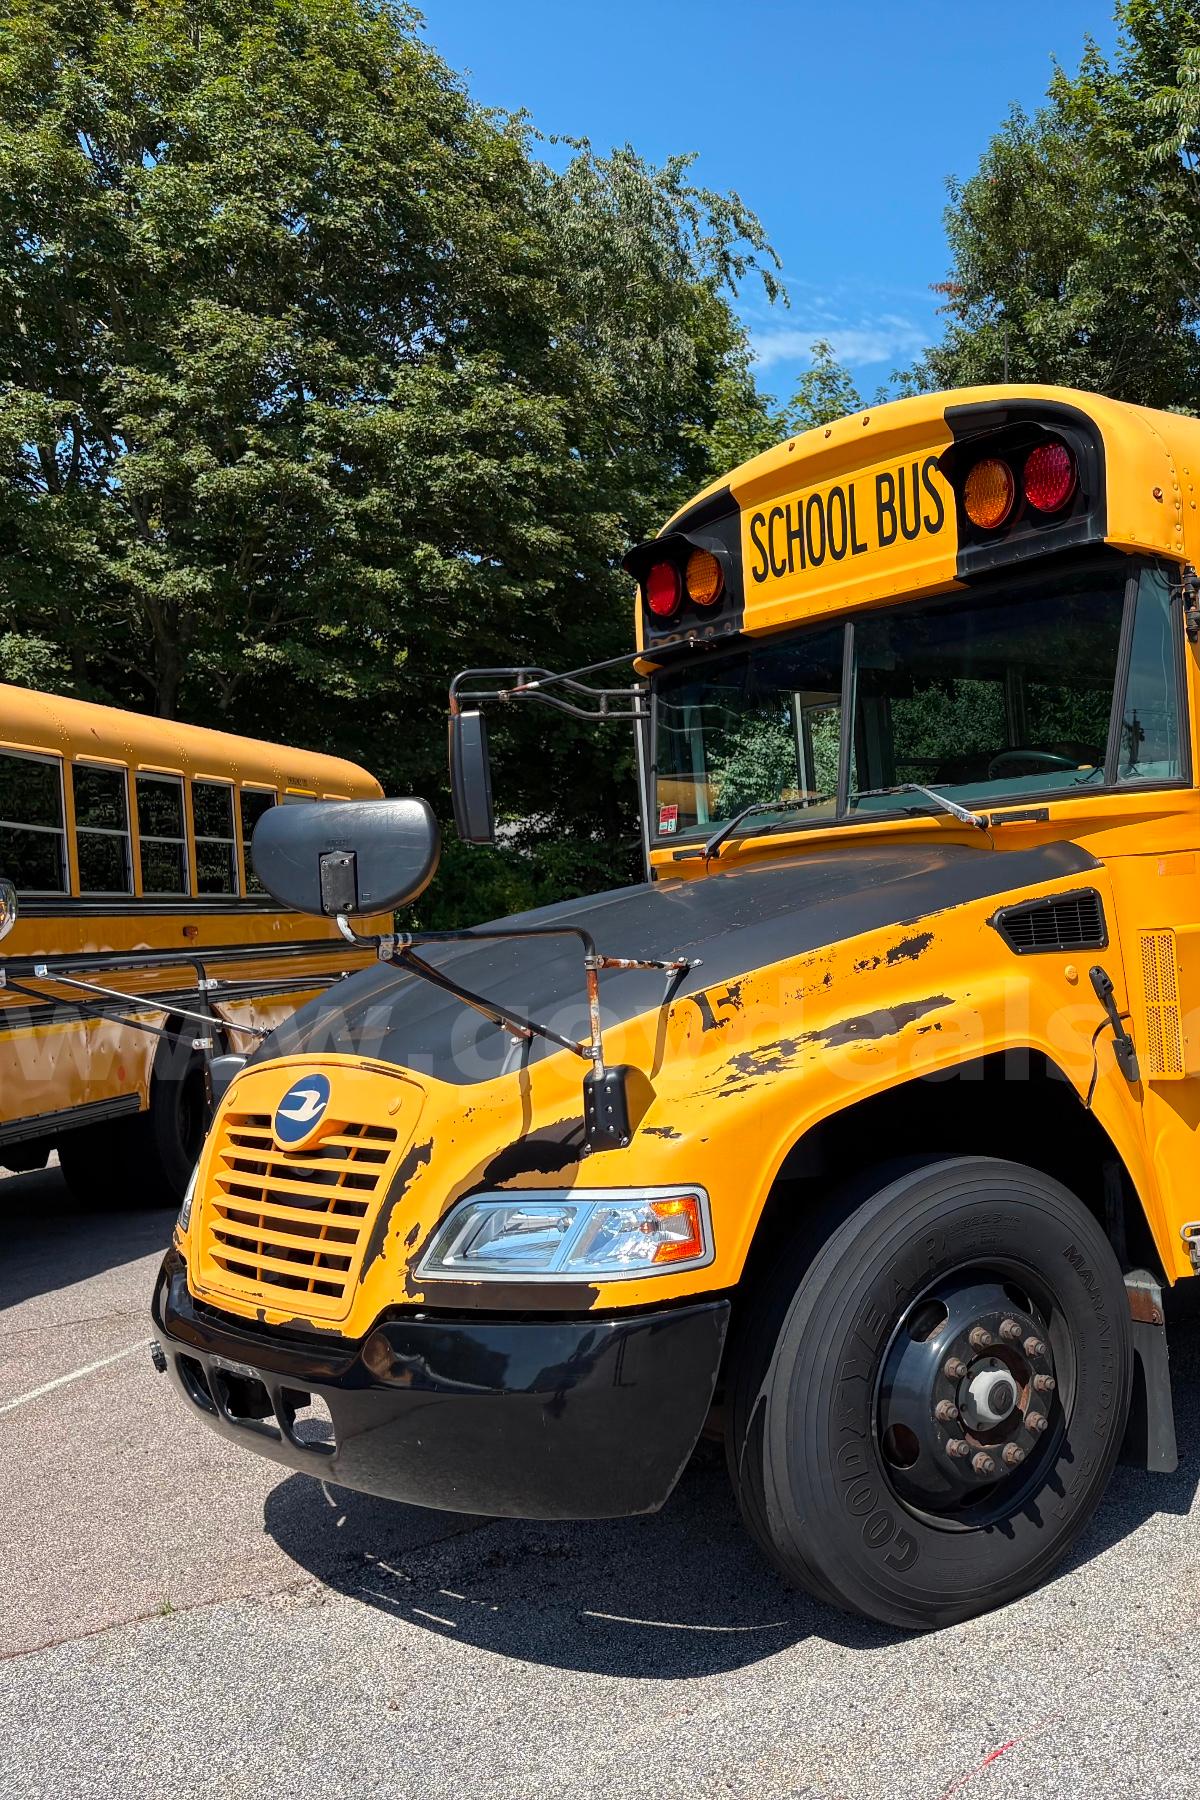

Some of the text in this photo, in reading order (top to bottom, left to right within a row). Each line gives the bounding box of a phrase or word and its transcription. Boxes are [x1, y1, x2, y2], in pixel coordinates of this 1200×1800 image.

[749, 454, 945, 584] SCHOOL BUS
[829, 1226, 950, 1574] GOODYEAR
[1061, 1242, 1115, 1441] MARATHON
